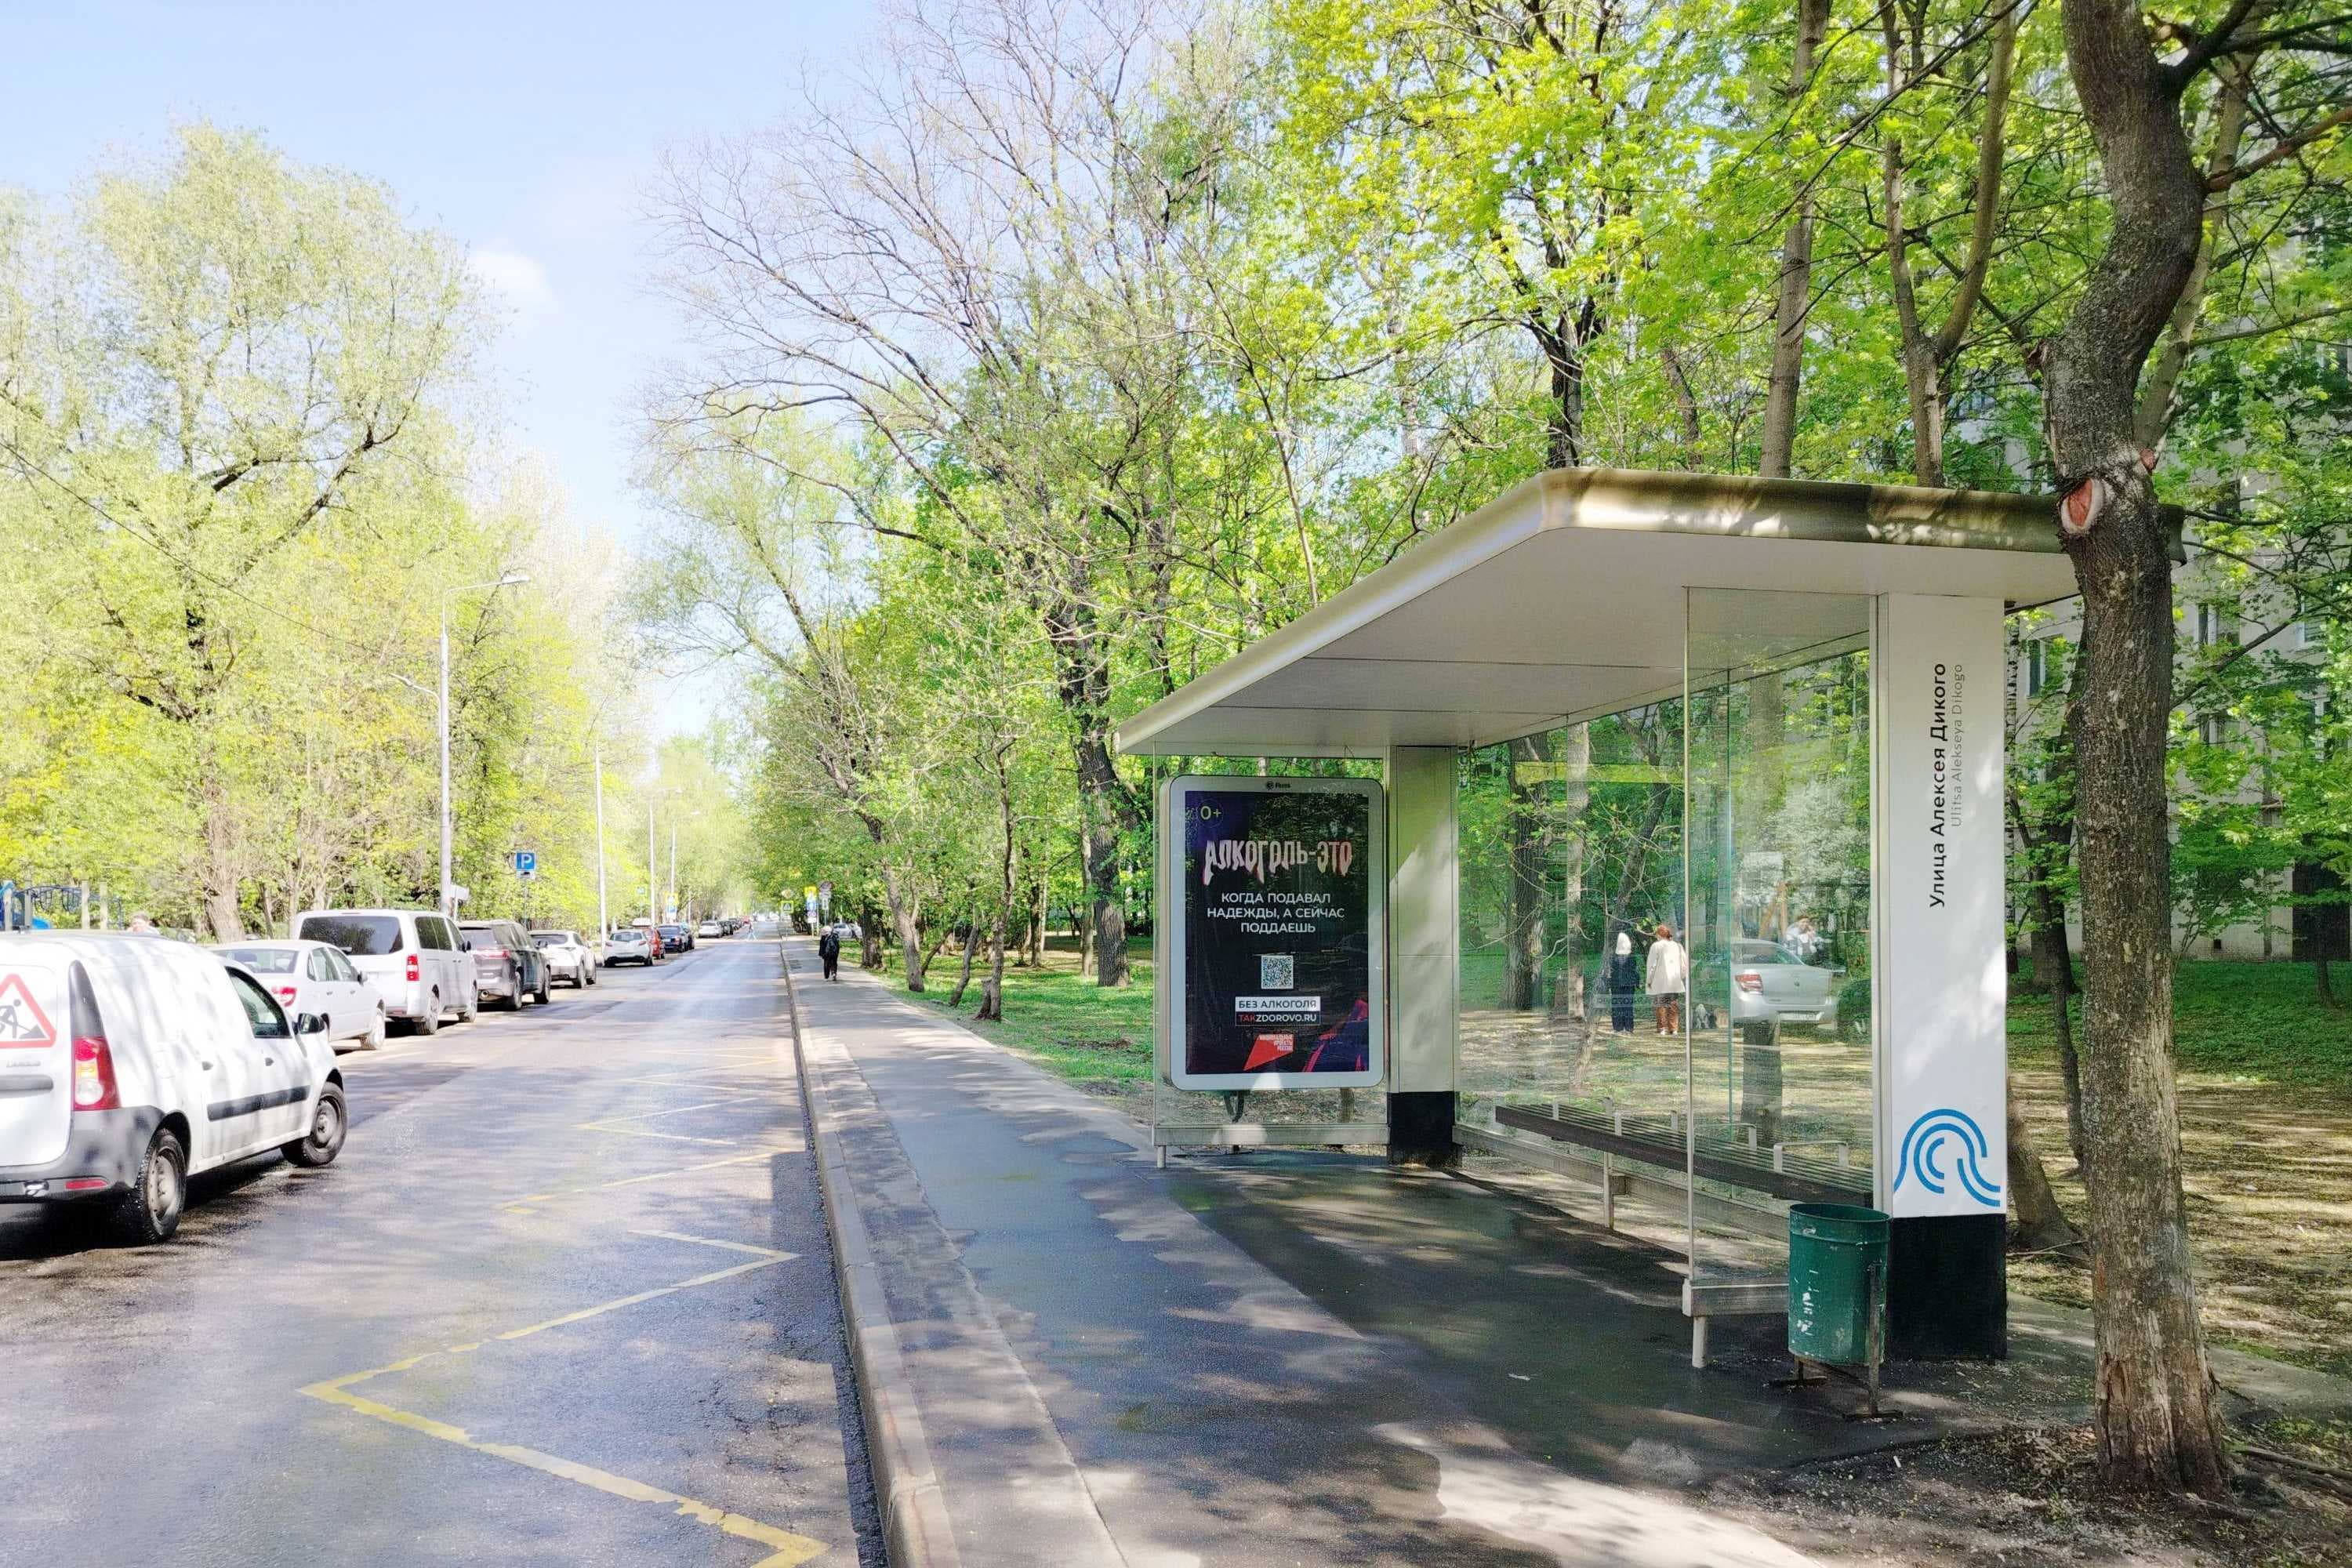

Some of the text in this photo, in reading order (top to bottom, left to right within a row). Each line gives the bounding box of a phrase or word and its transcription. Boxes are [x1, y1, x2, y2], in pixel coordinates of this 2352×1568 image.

[1951, 664, 1965, 827] Ulitsa Alekseya Dikogo
[1929, 664, 1947, 907] Улица Алексея Дикого
[1200, 805, 1221, 820] 0+
[1221, 893, 1331, 905] КОГДА ПОДАВАЛ
[1207, 906, 1345, 919] НАДЕЖДЫ, А СЕЙЧАС
[1240, 922, 1316, 935] ПОДДАЕШЬ
[1260, 1000, 1317, 1008] АЛКОГОЛЯ
